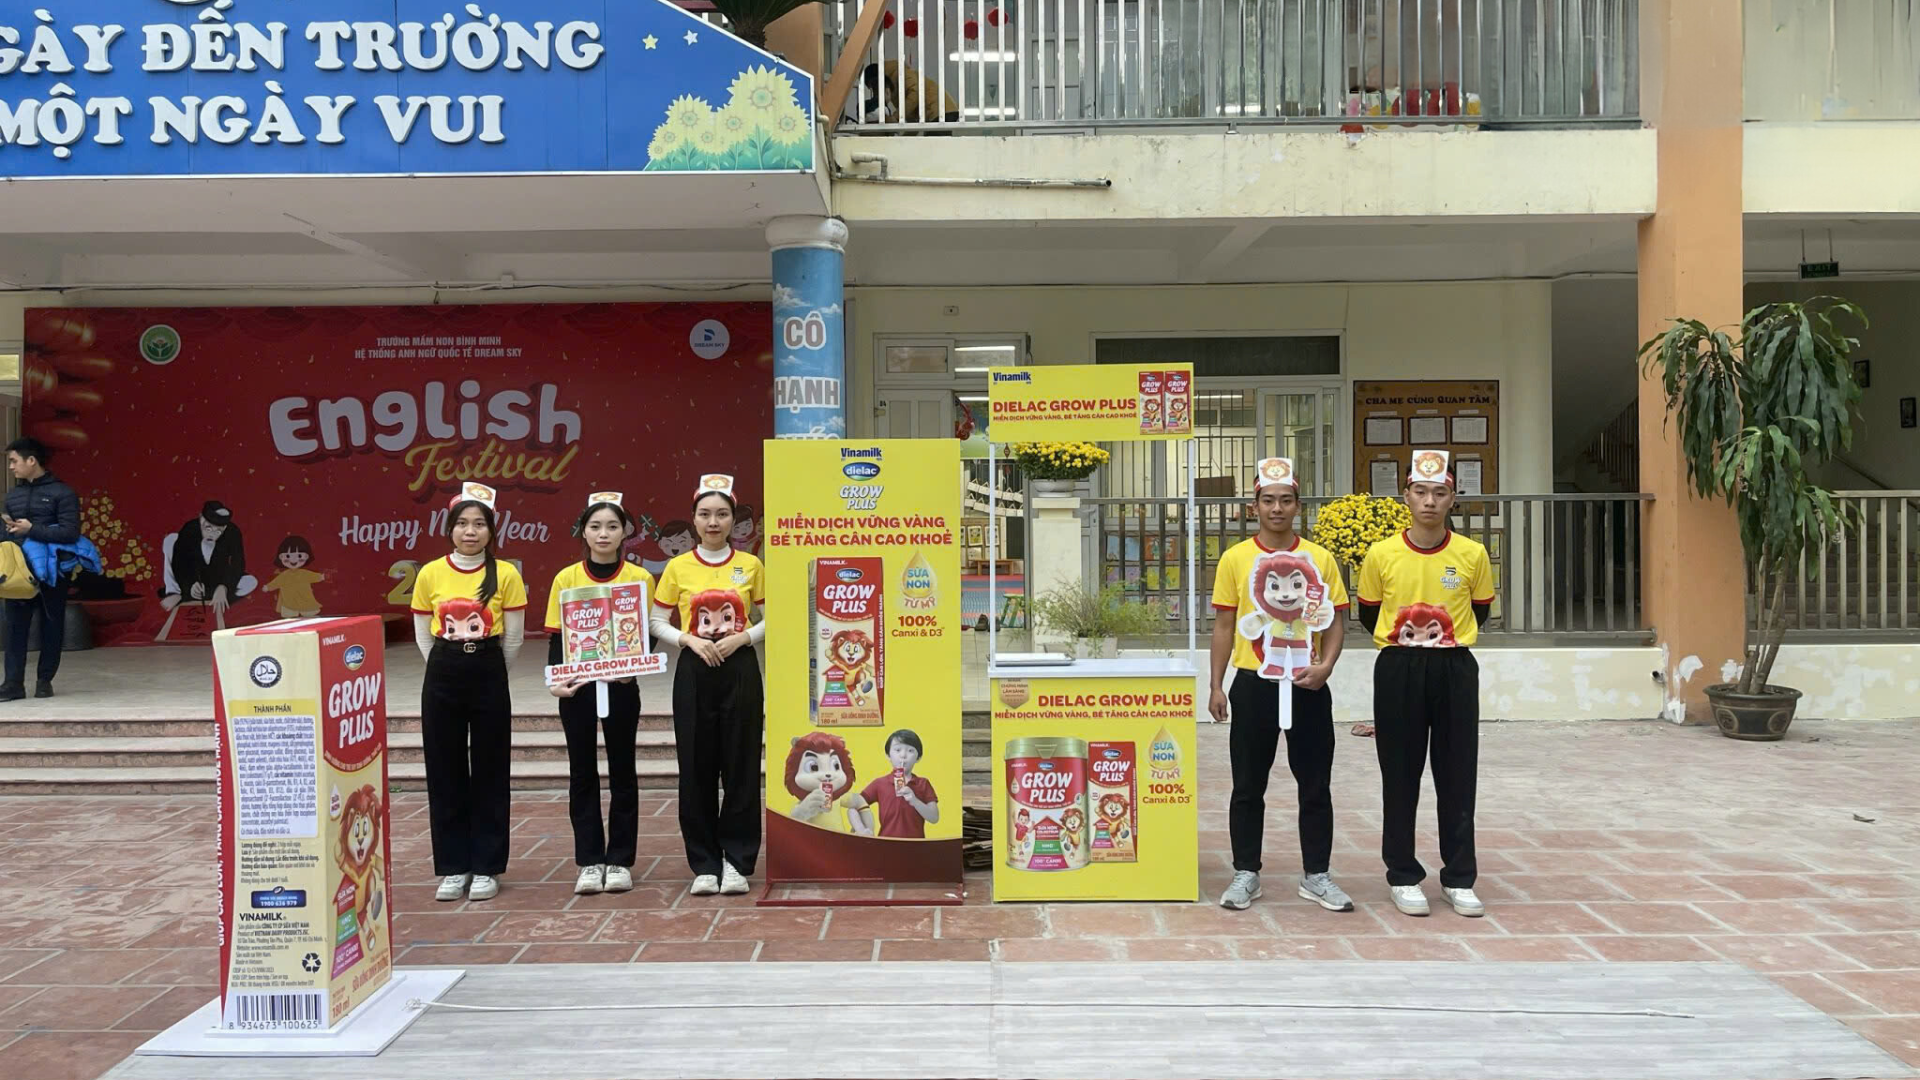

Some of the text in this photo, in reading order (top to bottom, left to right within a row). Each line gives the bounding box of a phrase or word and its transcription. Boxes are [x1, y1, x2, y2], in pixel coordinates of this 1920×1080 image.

[141, 0, 287, 71] ĐẾN
[305, 4, 604, 70] TRƯỜNG
[149, 80, 355, 144] NGÀY
[374, 95, 505, 144] VUI
[784, 310, 827, 350] CÔ
[376, 337, 410, 347] TRƯỜNG
[436, 337, 454, 346] NON
[456, 335, 476, 346] BÌNH
[478, 336, 501, 346] MINH
[368, 348, 396, 359] THỐNG
[398, 349, 416, 358] ANH
[475, 348, 504, 357] DREAM
[506, 348, 522, 357] SKY
[993, 372, 1031, 382] Vinamilk
[775, 376, 840, 413] HẠNH
[1365, 397, 1388, 405] CHA
[1437, 396, 1465, 404] QUAN
[1468, 394, 1490, 404] TÂM
[993, 398, 1136, 413] DIELAC GROW PLUS
[269, 380, 581, 457] English
[841, 448, 882, 458] Vinamilk
[405, 439, 579, 491] Festival
[846, 465, 878, 475] dielac
[840, 485, 884, 499] GROW
[847, 499, 877, 510] PLUS
[777, 512, 945, 532] MIỄN DỊCH VỮNG VÀNG
[339, 515, 422, 551] Happy
[771, 532, 791, 546] BÉ
[794, 531, 836, 546] TĂNG
[840, 531, 872, 546] CÂN
[875, 534, 906, 546] CAO
[839, 570, 861, 578] dielac
[907, 567, 928, 578] SỮA
[907, 579, 930, 589] NON
[823, 584, 875, 600] GROW
[615, 596, 638, 606] GROW
[832, 600, 867, 614] PLUS
[572, 607, 603, 620] GROW
[577, 618, 599, 629] PLUS
[898, 615, 937, 627] 100%
[891, 629, 918, 637] Canxi
[920, 629, 928, 637] &
[322, 634, 345, 646] VINAMILK
[551, 655, 660, 676] DIELAC GROW PLUS
[328, 671, 381, 718] GROW
[1038, 694, 1193, 707] DIELAC GROW PLUS
[254, 704, 274, 713] THÀNH
[995, 709, 1016, 719] MIỄN
[1017, 710, 1037, 720] DỊCH
[1092, 709, 1103, 718] BÉ
[1105, 709, 1128, 718] TĂNG
[1130, 709, 1148, 718] CÂN
[1149, 710, 1168, 718] CAO
[339, 710, 375, 748] PLUS
[1153, 740, 1174, 751] SỮA
[1153, 753, 1175, 761] NON
[1093, 760, 1131, 772] GROW
[1021, 772, 1073, 789] GROW
[1099, 772, 1125, 782] PLUS
[1148, 783, 1185, 794] 100%
[1030, 789, 1066, 803] PLUS
[1142, 795, 1167, 804] Canxi
[1169, 796, 1176, 804] &
[239, 912, 283, 921] VINAMILK
[229, 1021, 318, 1030] 8 934673 100625
